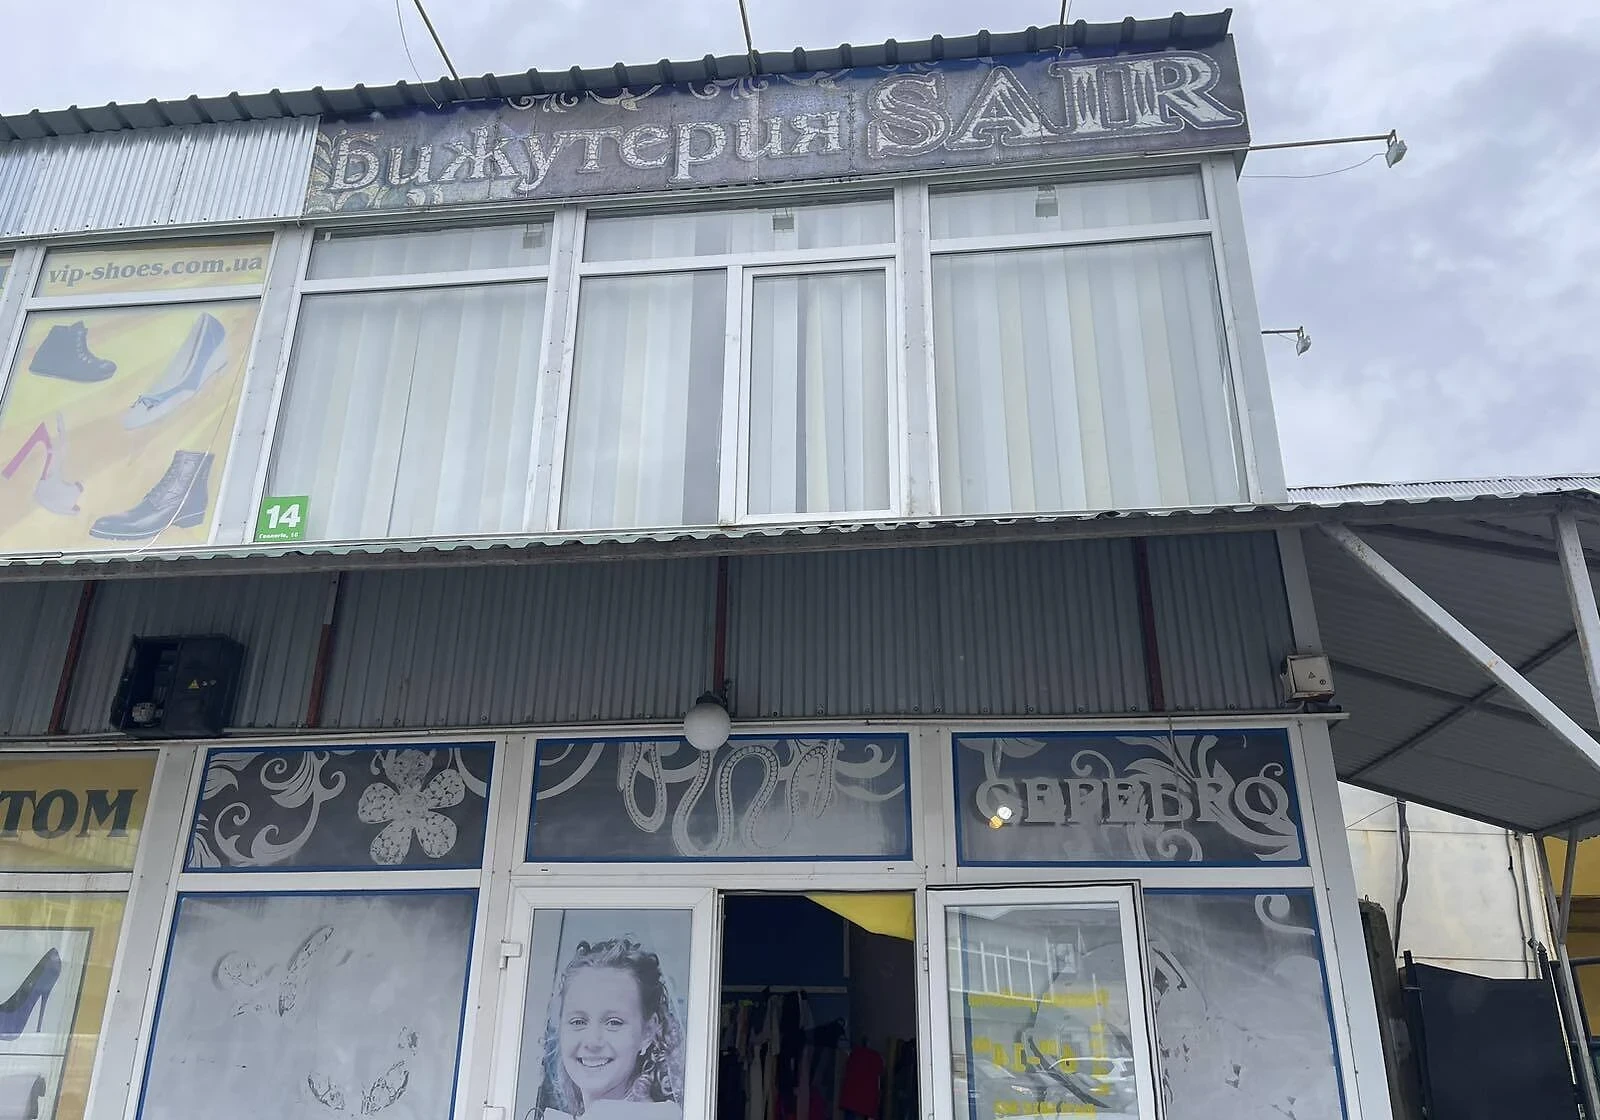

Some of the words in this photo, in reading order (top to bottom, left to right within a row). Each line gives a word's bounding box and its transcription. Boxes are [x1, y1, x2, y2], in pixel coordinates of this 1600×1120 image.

[49, 256, 263, 288] vip-shoes.com.ua
[266, 503, 301, 529] 14
[975, 776, 1289, 826] СЕРЕБРО
